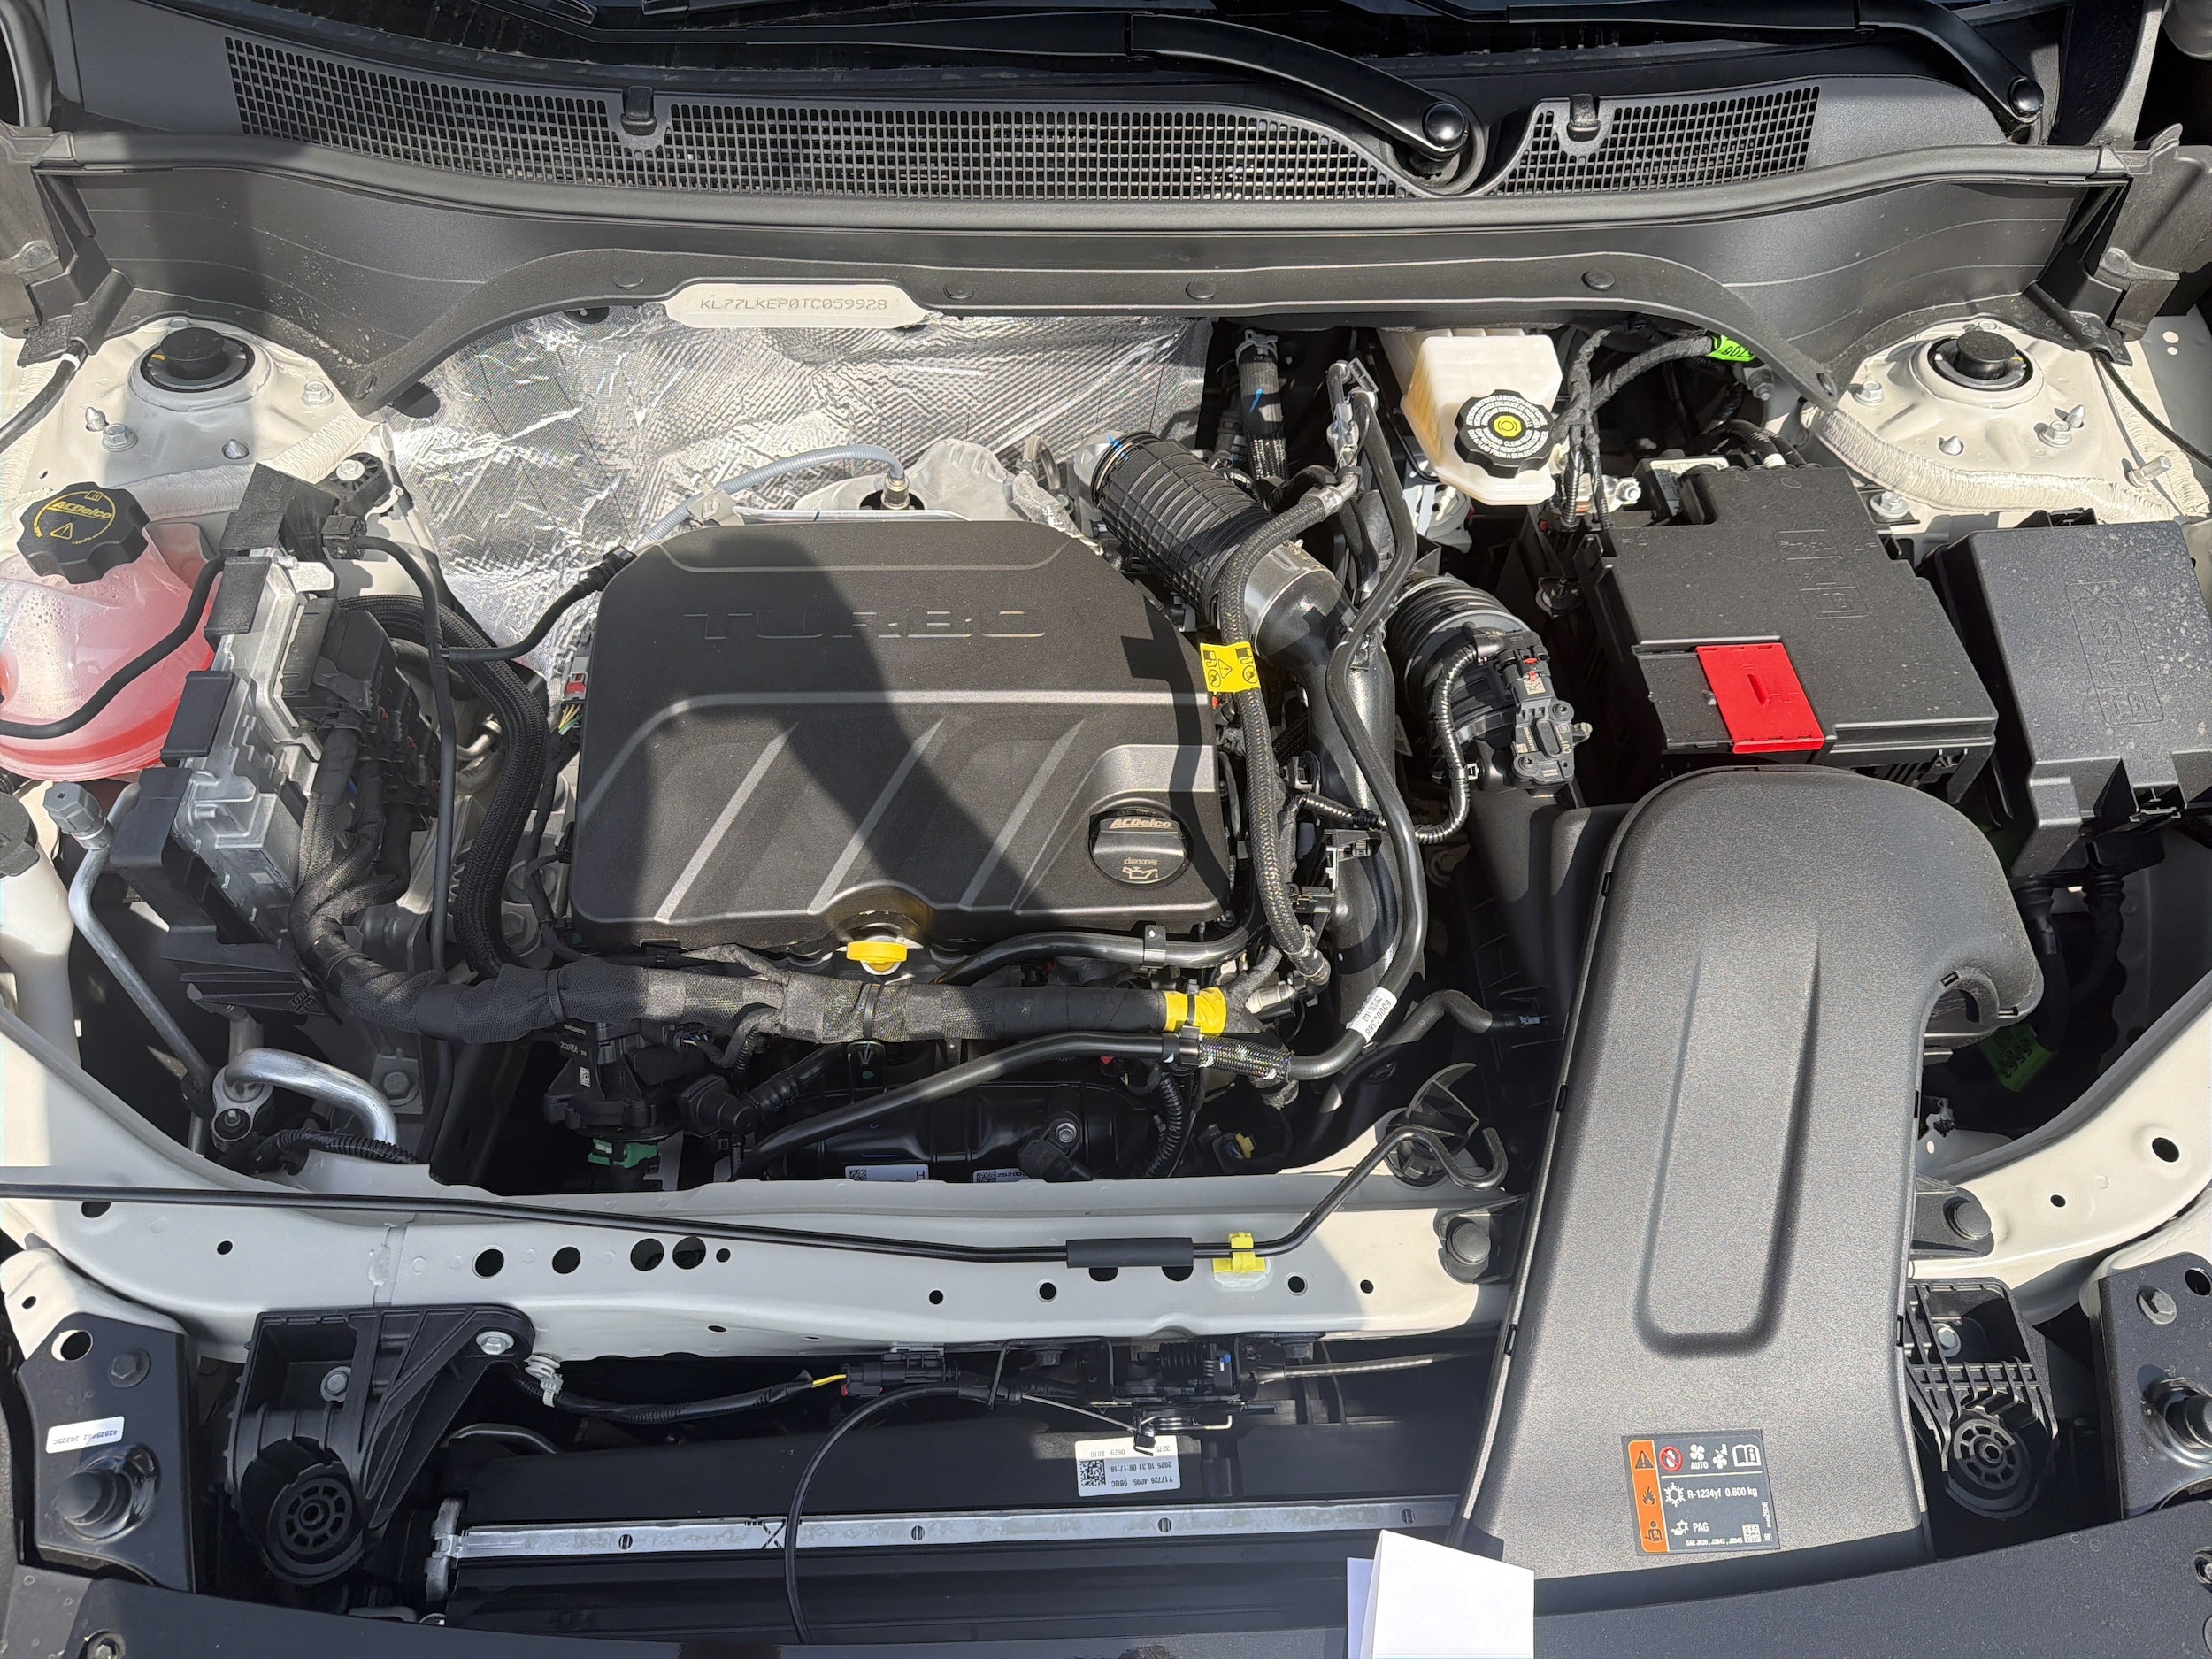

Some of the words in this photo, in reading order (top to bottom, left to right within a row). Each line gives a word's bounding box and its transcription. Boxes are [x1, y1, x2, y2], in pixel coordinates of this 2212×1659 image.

[51, 501, 113, 520] ACDelco
[683, 611, 1046, 640] TURBO
[1109, 818, 1173, 830] ACDelco
[1123, 856, 1158, 866] dexos
[1690, 1461, 1709, 1470] AUTO
[1686, 1488, 1722, 1500] R-1234yf
[1724, 1487, 1747, 1497] 0.600
[1747, 1486, 1758, 1497] kg
[1692, 1521, 1709, 1532] PAG
